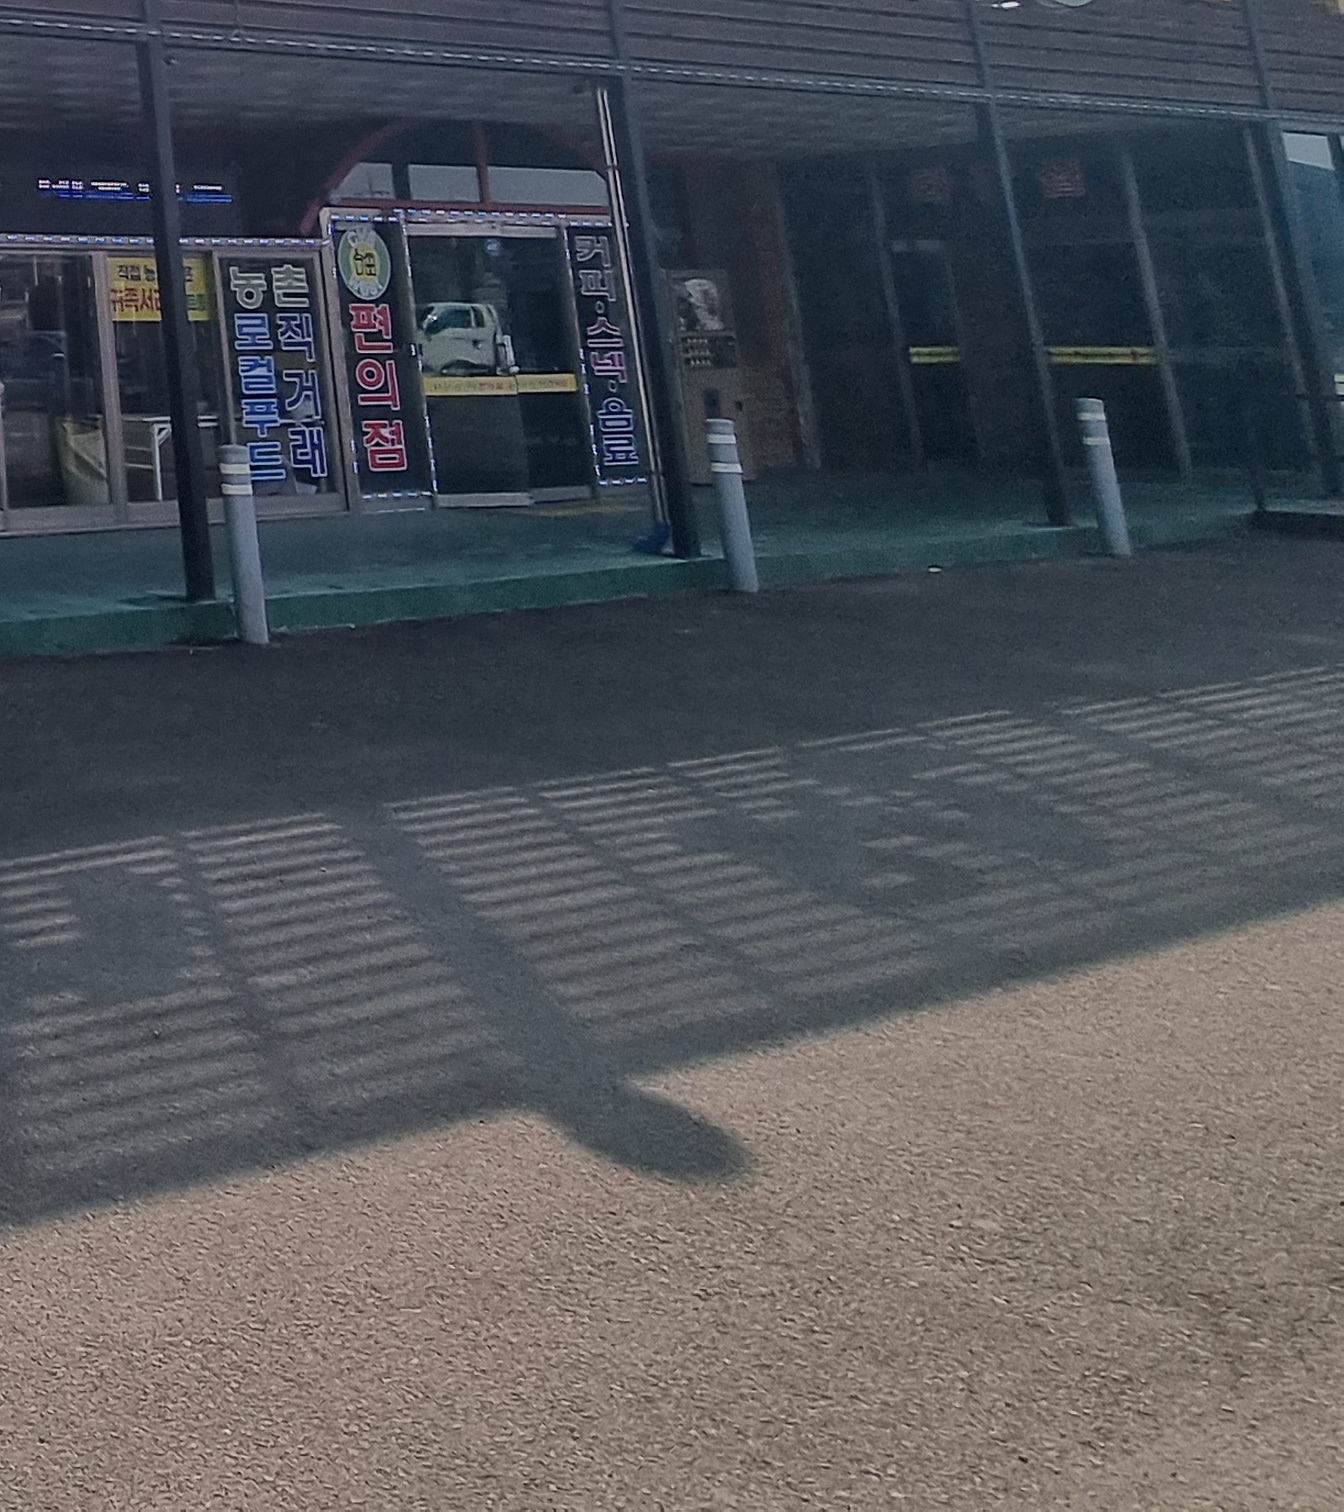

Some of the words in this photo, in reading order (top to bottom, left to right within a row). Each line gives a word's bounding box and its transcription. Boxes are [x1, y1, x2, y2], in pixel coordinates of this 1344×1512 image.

[229, 264, 311, 310] 농촌
[234, 313, 287, 481] 로컬푸드
[276, 313, 328, 478] 직거래
[348, 303, 408, 472] 편의점
